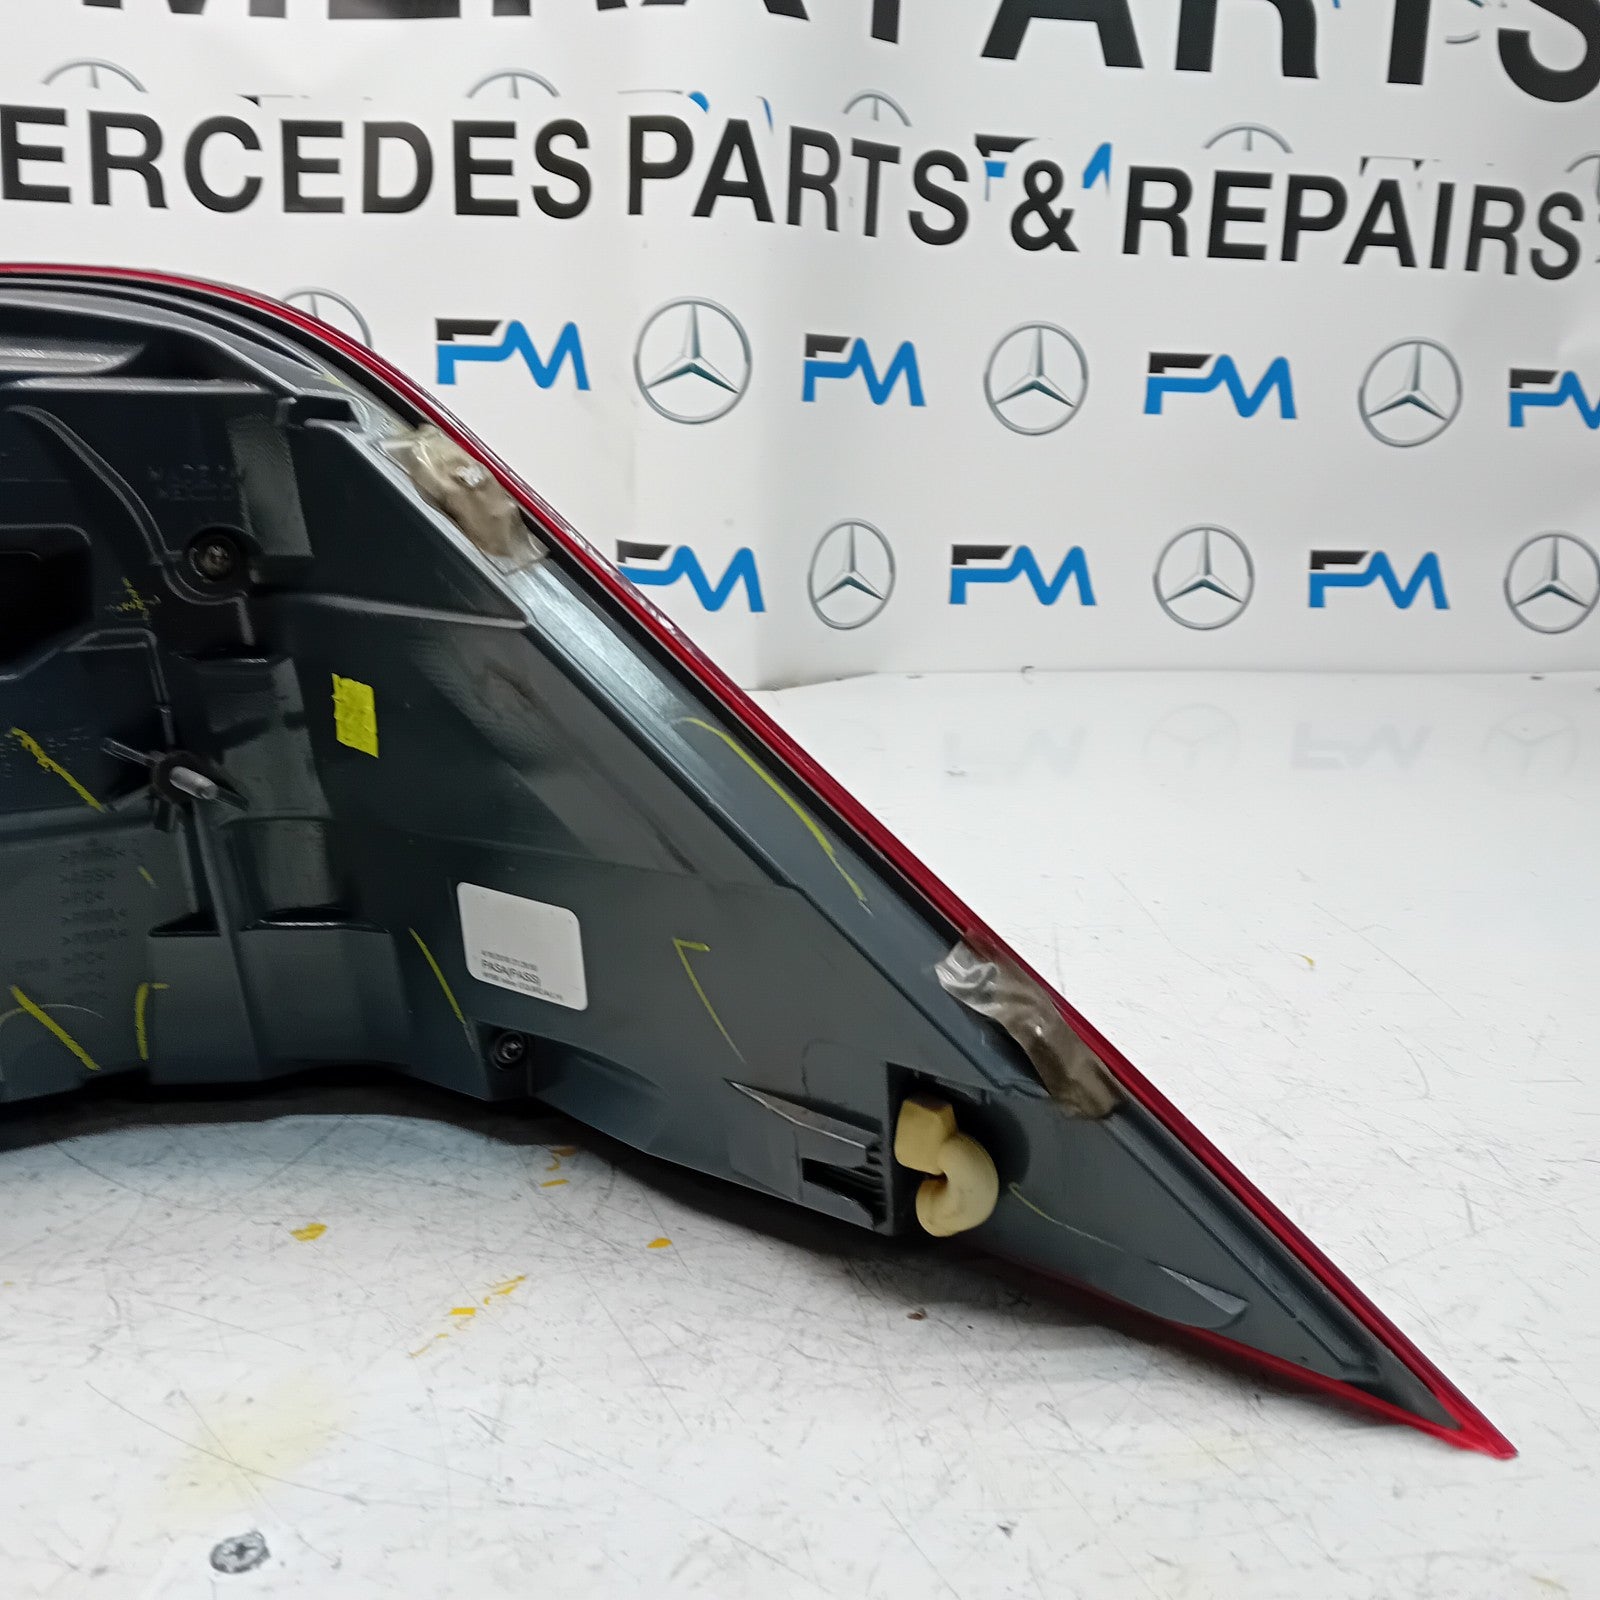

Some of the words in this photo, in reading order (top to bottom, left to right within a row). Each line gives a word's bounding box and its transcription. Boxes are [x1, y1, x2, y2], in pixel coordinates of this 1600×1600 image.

[629, 116, 969, 246] PARTS
[1010, 160, 1079, 252] &
[1122, 166, 1584, 281] REPAIRS
[435, 318, 590, 391] FM
[802, 333, 926, 407] FM
[1144, 352, 1297, 419] FM
[949, 544, 1096, 606] FM
[1308, 550, 1450, 610] FM
